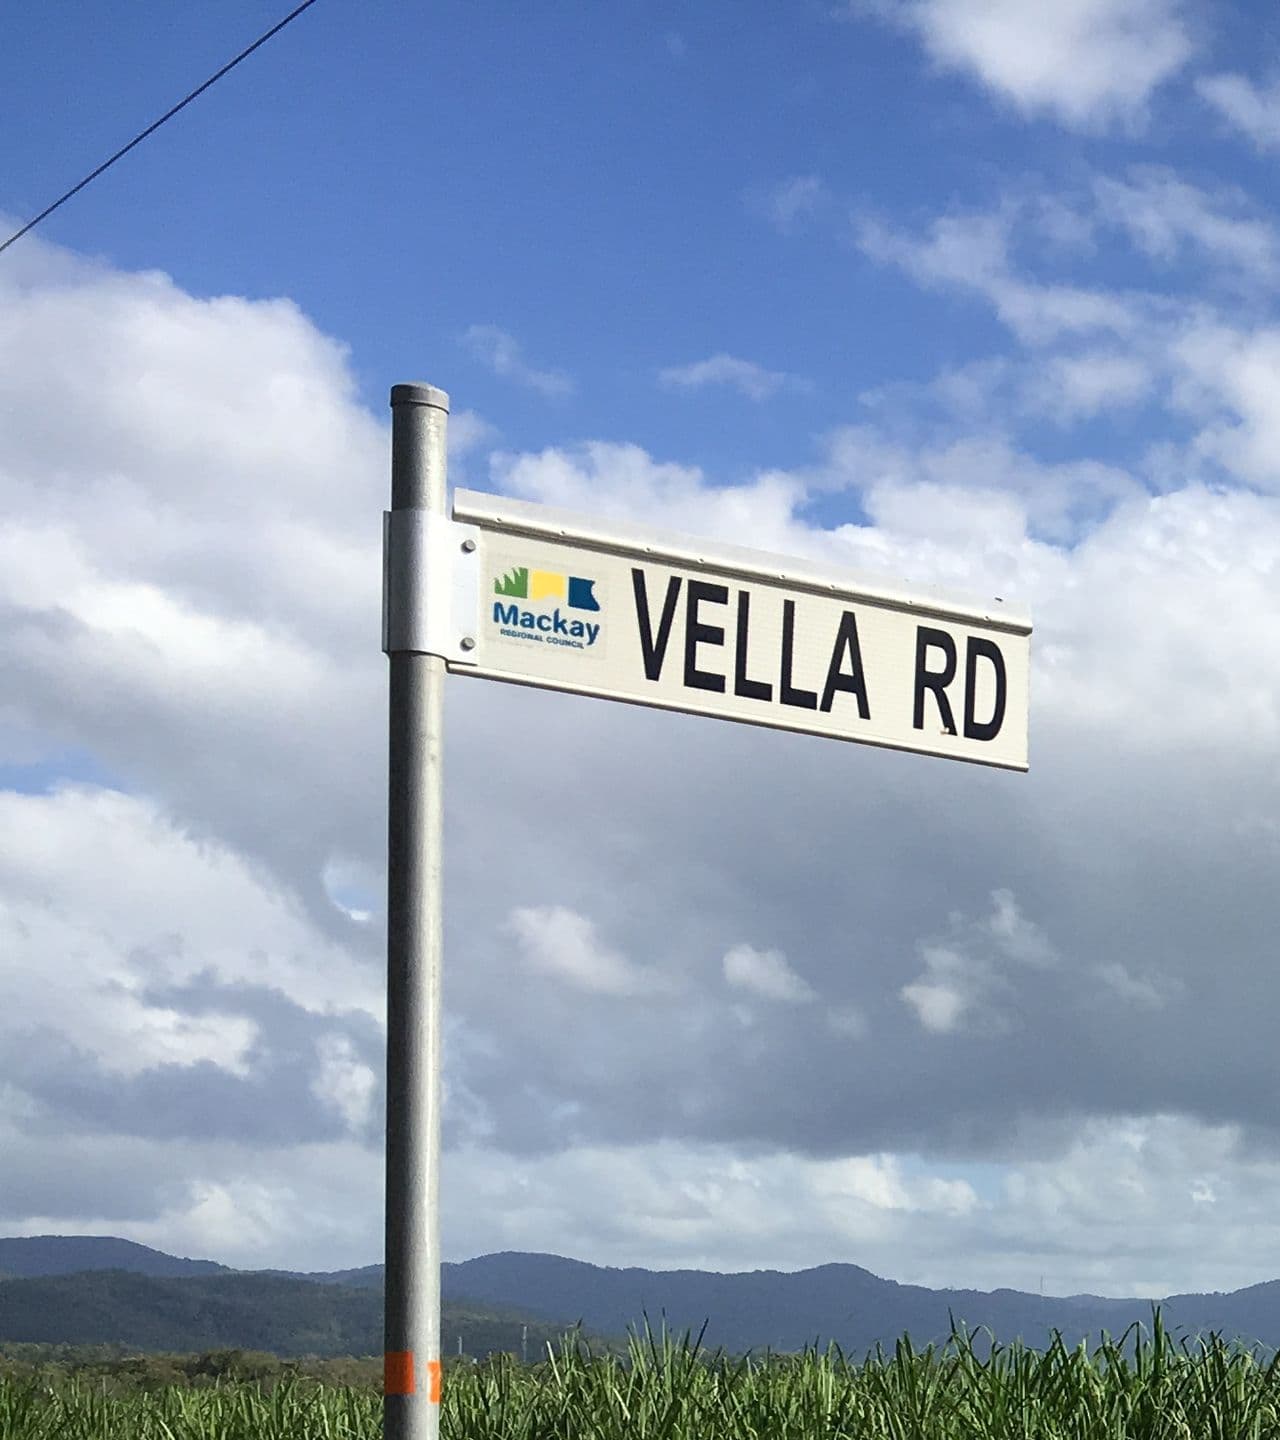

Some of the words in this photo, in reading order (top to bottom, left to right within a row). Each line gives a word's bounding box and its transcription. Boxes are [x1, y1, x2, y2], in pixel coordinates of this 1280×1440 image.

[493, 602, 600, 645] Mackay
[500, 628, 543, 642] REGIONAL
[546, 636, 584, 649] COUNCIL
[632, 568, 870, 720] VELLA
[913, 626, 1007, 742] RD
